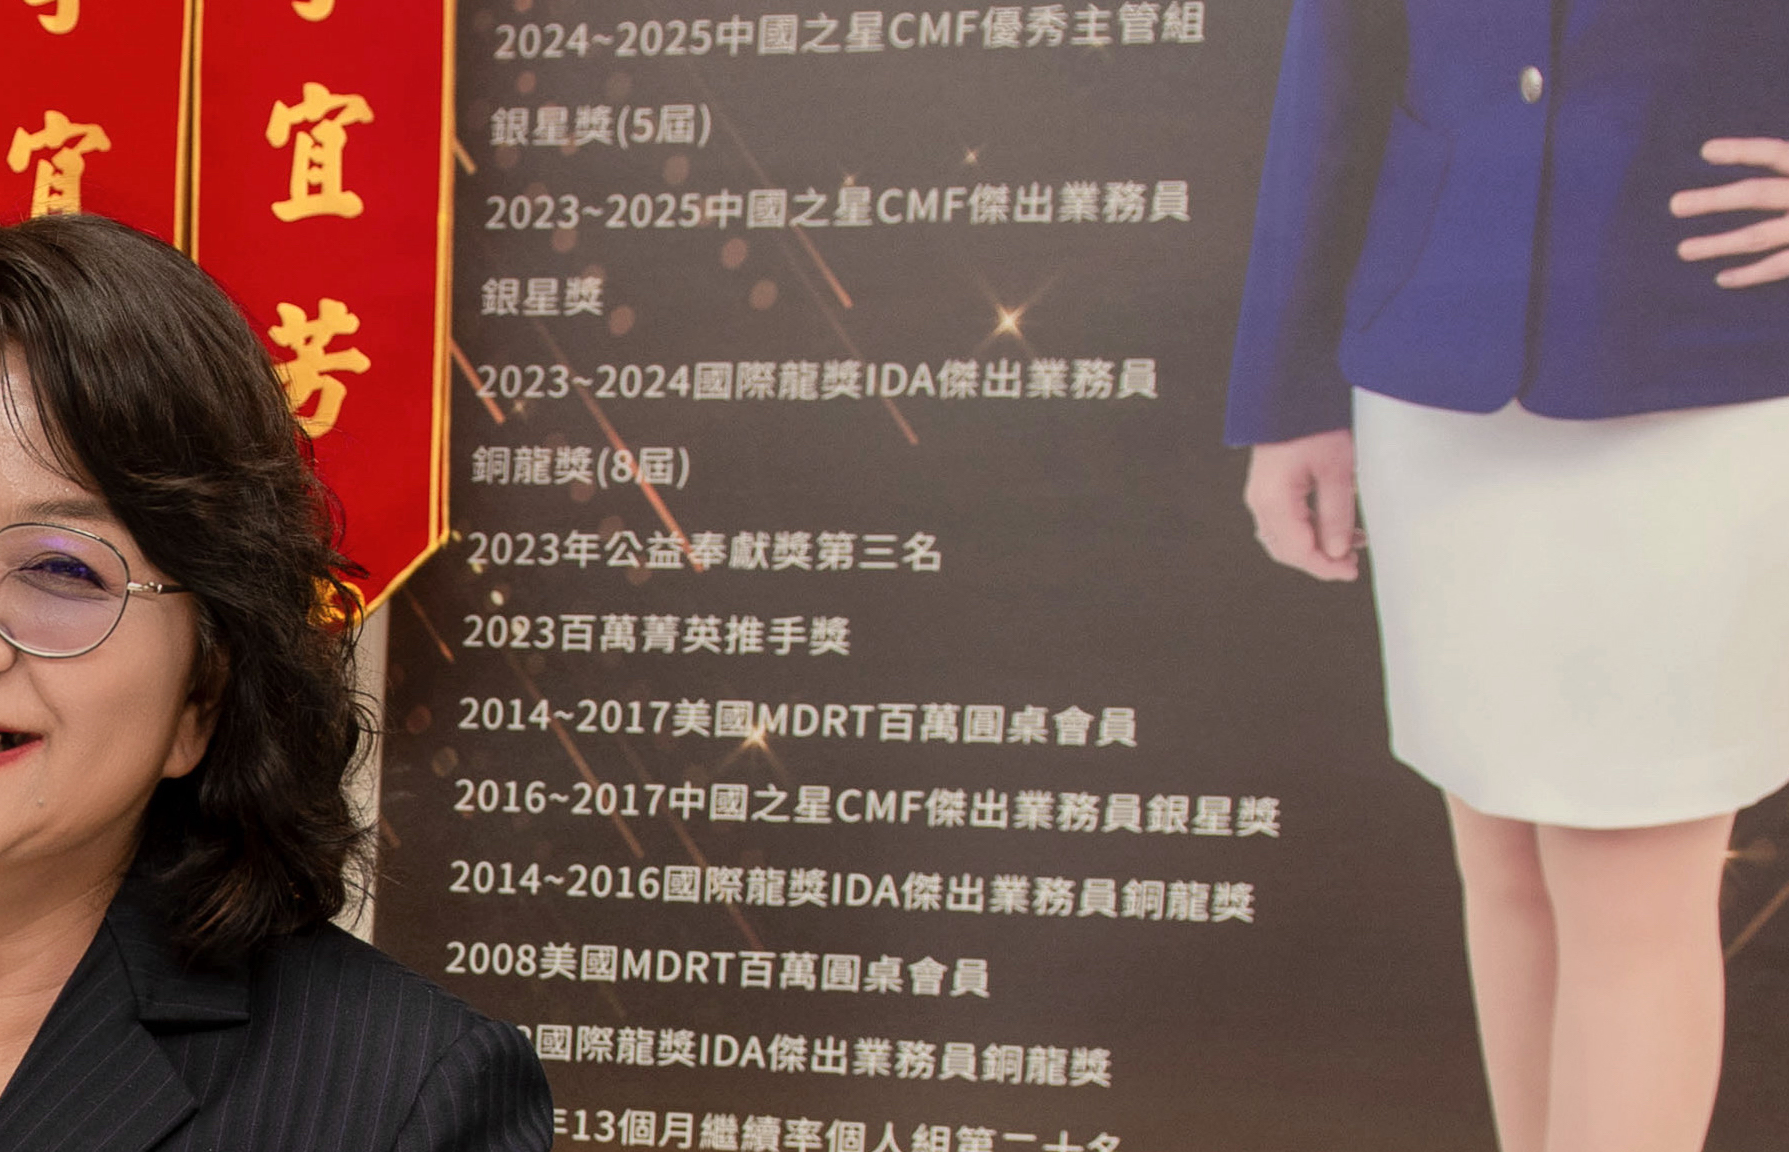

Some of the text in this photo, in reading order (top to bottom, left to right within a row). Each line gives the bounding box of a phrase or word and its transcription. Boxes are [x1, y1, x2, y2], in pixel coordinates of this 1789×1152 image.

[494, 1, 1205, 60] 2024~2025中國之星CMF優秀主管組
[484, 180, 1190, 230] 2023~2025中國之星CMF傑出業務員
[481, 276, 604, 316] 銀星獎
[475, 357, 1159, 402] 2023~2024國際龍獎IDA傑出業務員
[466, 529, 942, 574] 2023年公益奉獻獎第三名
[462, 613, 851, 656] 2023百萬菁英推手獎
[457, 697, 1138, 748] 2014~2017美國MDRT百萬圓桌會員
[453, 779, 1281, 838] 2016~2017中國之星CMF傑出業務員銀星獎
[448, 860, 1255, 923] 2014~2016國際龍獎IDA傑出業務員銅龍獎
[444, 940, 990, 998] 2008美國MDRT百萬圓桌會員
